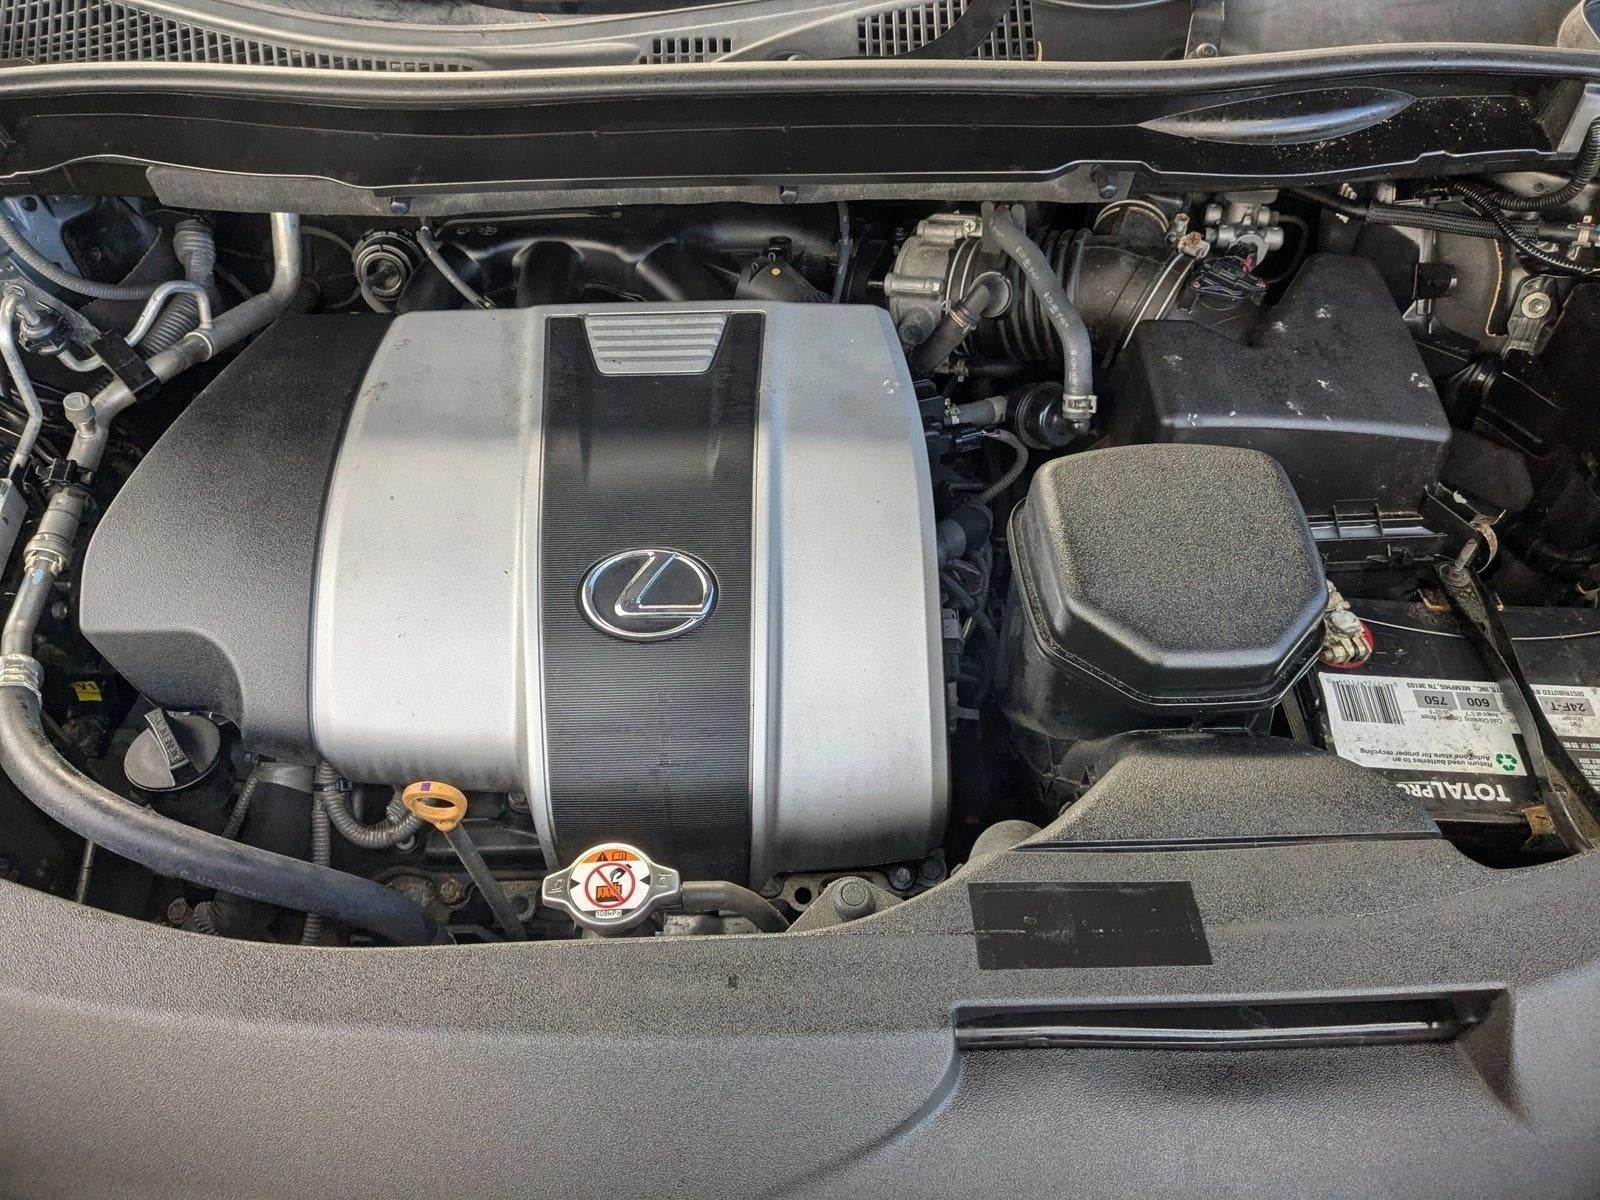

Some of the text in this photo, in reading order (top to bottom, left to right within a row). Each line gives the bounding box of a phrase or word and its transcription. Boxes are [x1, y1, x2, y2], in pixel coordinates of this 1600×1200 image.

[1437, 683, 1471, 691] MEMPHIS,
[1424, 695, 1448, 706] 750
[1466, 697, 1490, 707] 600
[1550, 701, 1586, 712] 24F-T
[1360, 747, 1394, 757] recycling
[1412, 758, 1446, 766] batteries
[1467, 760, 1493, 768] Return
